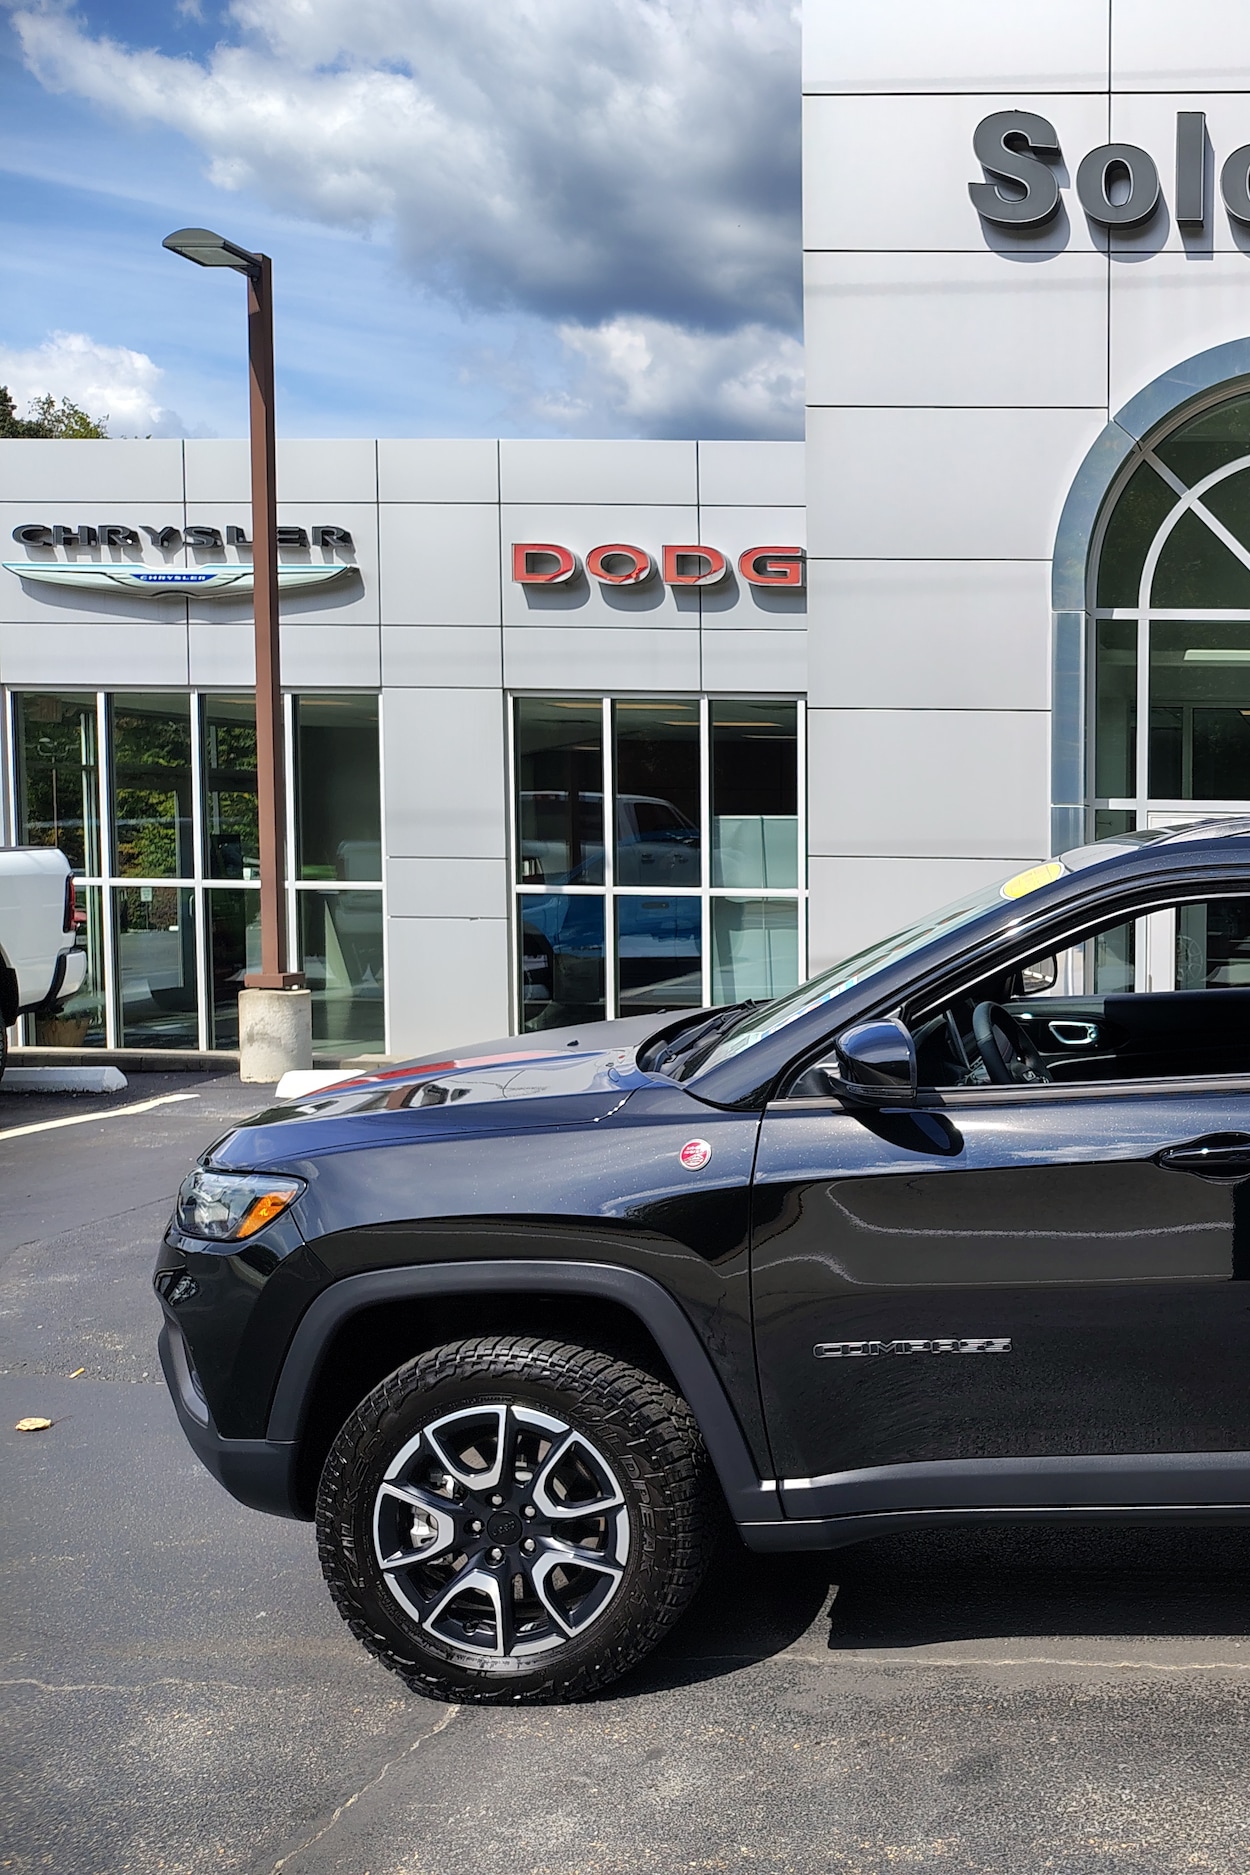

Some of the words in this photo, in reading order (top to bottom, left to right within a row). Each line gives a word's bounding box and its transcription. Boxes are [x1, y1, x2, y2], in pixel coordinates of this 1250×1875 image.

[12, 524, 352, 549] CHRYSLER
[511, 541, 806, 587] DODG
[140, 574, 207, 582] CHRYSLER
[813, 1337, 1013, 1359] COMPASS
